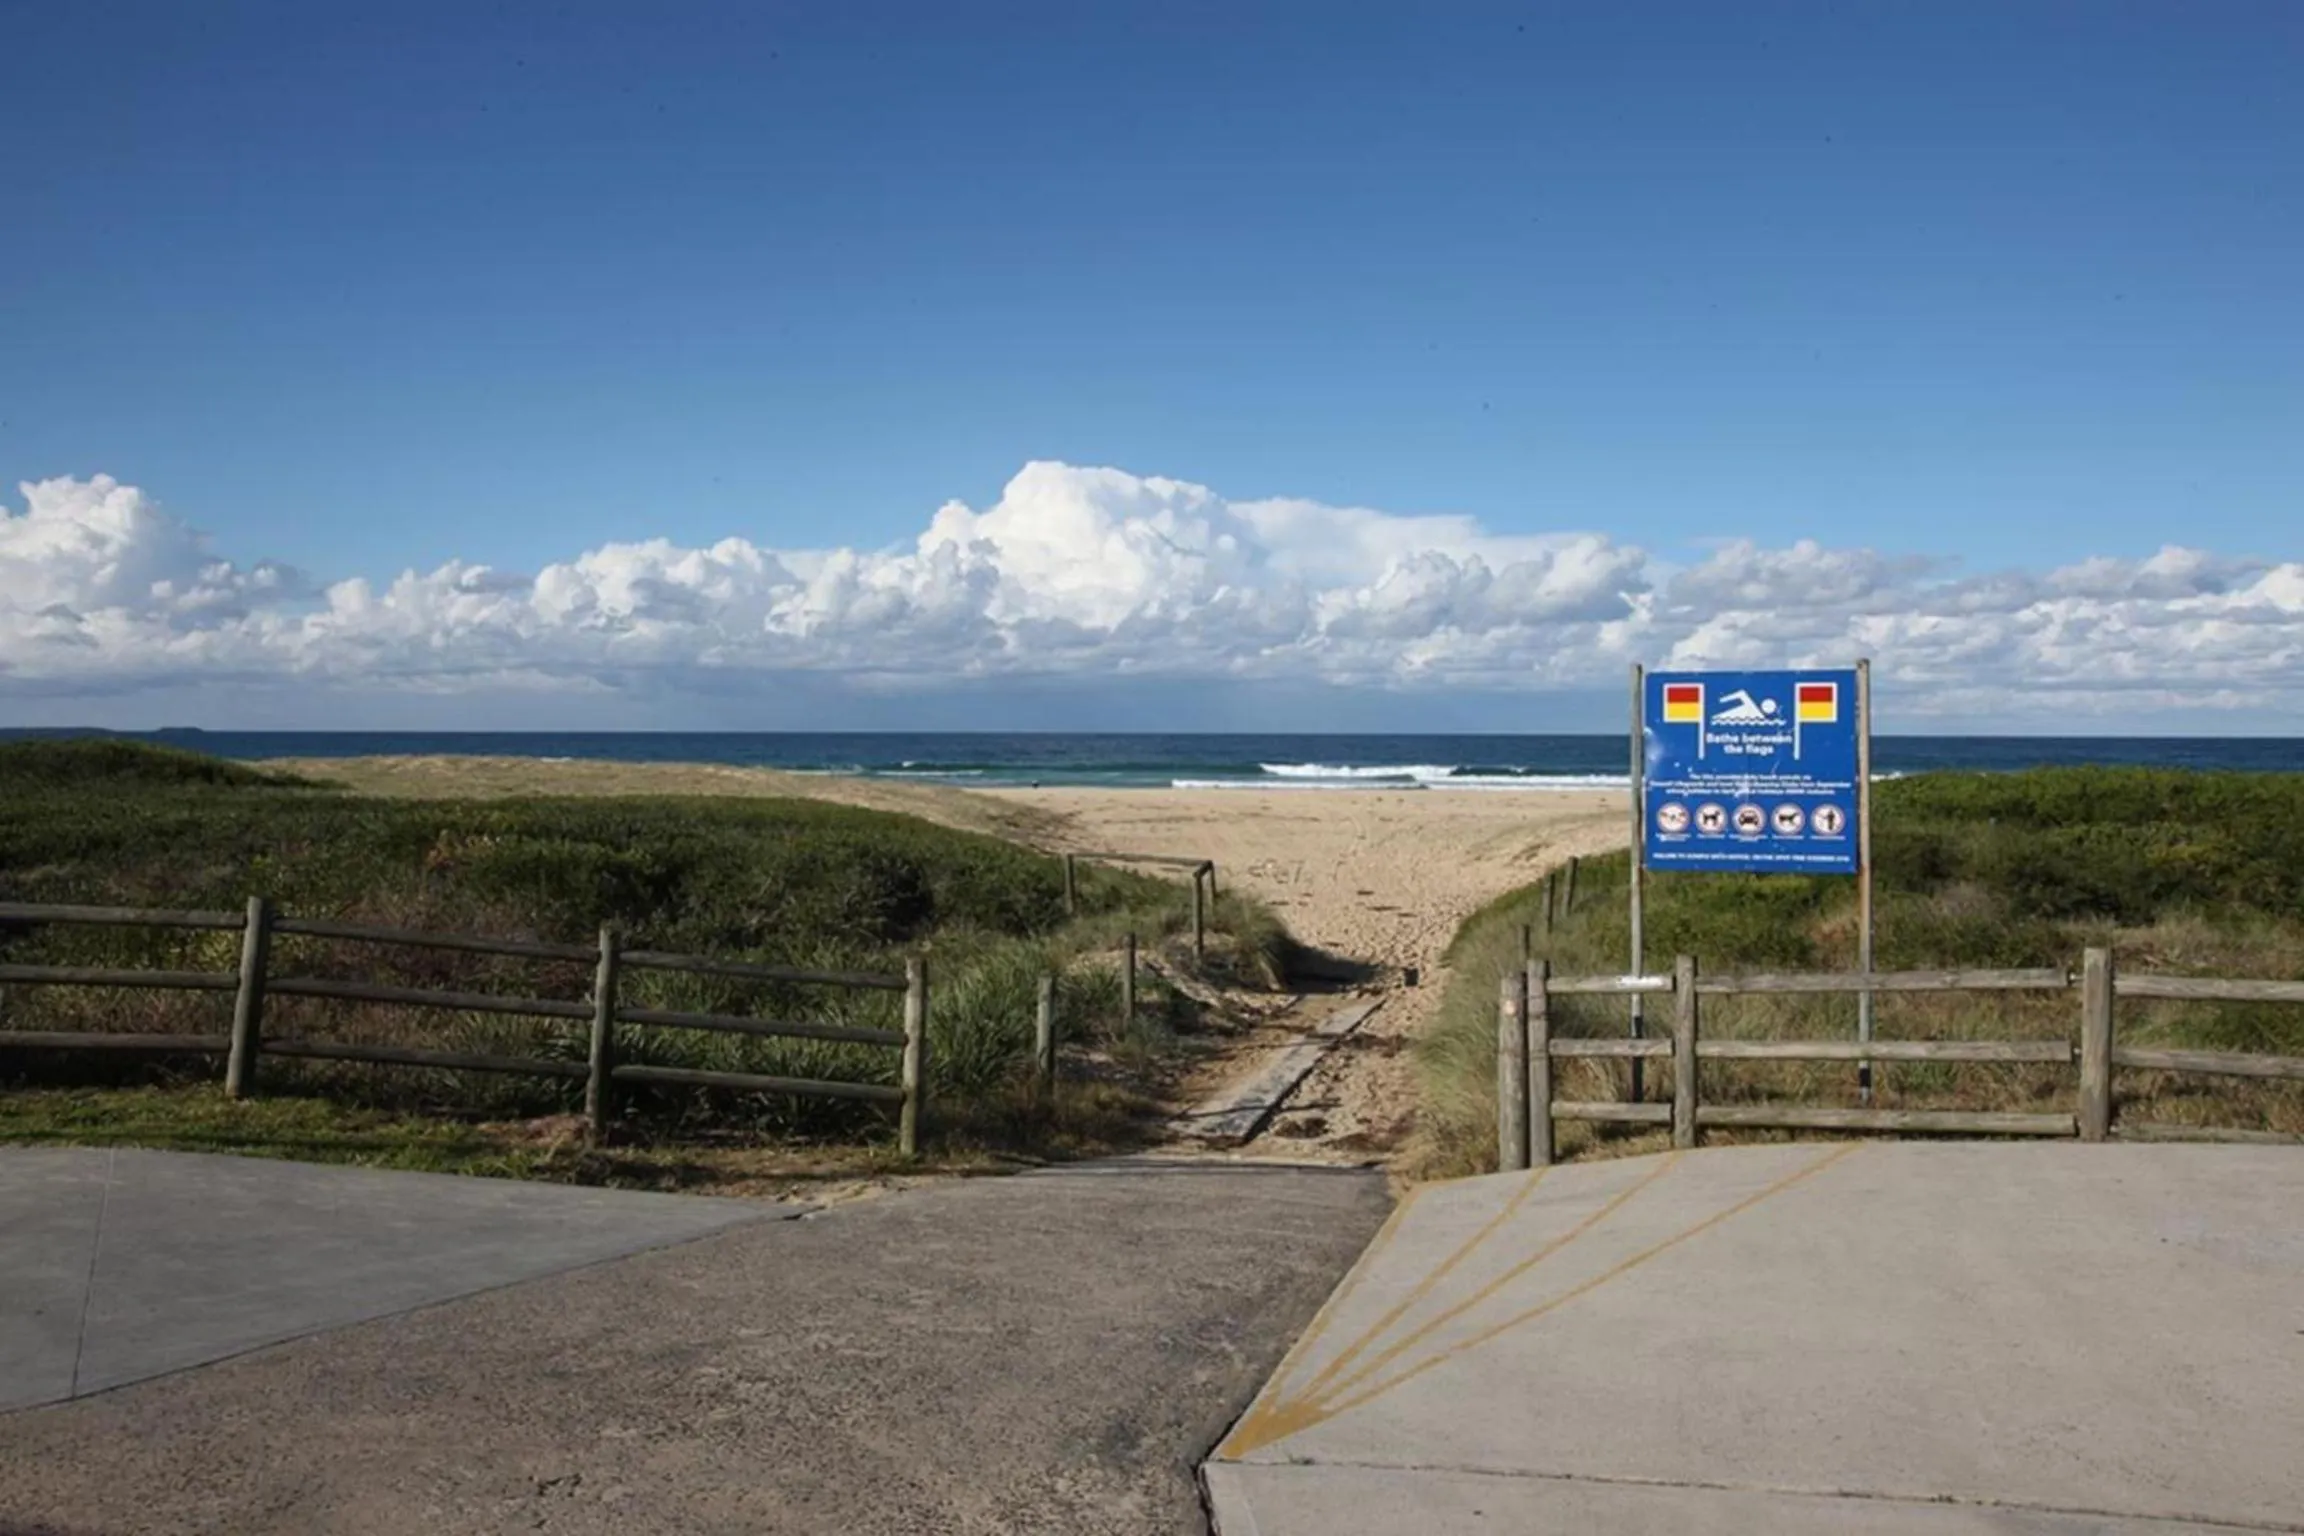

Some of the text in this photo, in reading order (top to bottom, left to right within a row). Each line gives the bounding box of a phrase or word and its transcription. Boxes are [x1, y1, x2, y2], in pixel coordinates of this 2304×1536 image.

[1707, 732, 1793, 744] Bathe between
[1724, 743, 1774, 756] the flags
